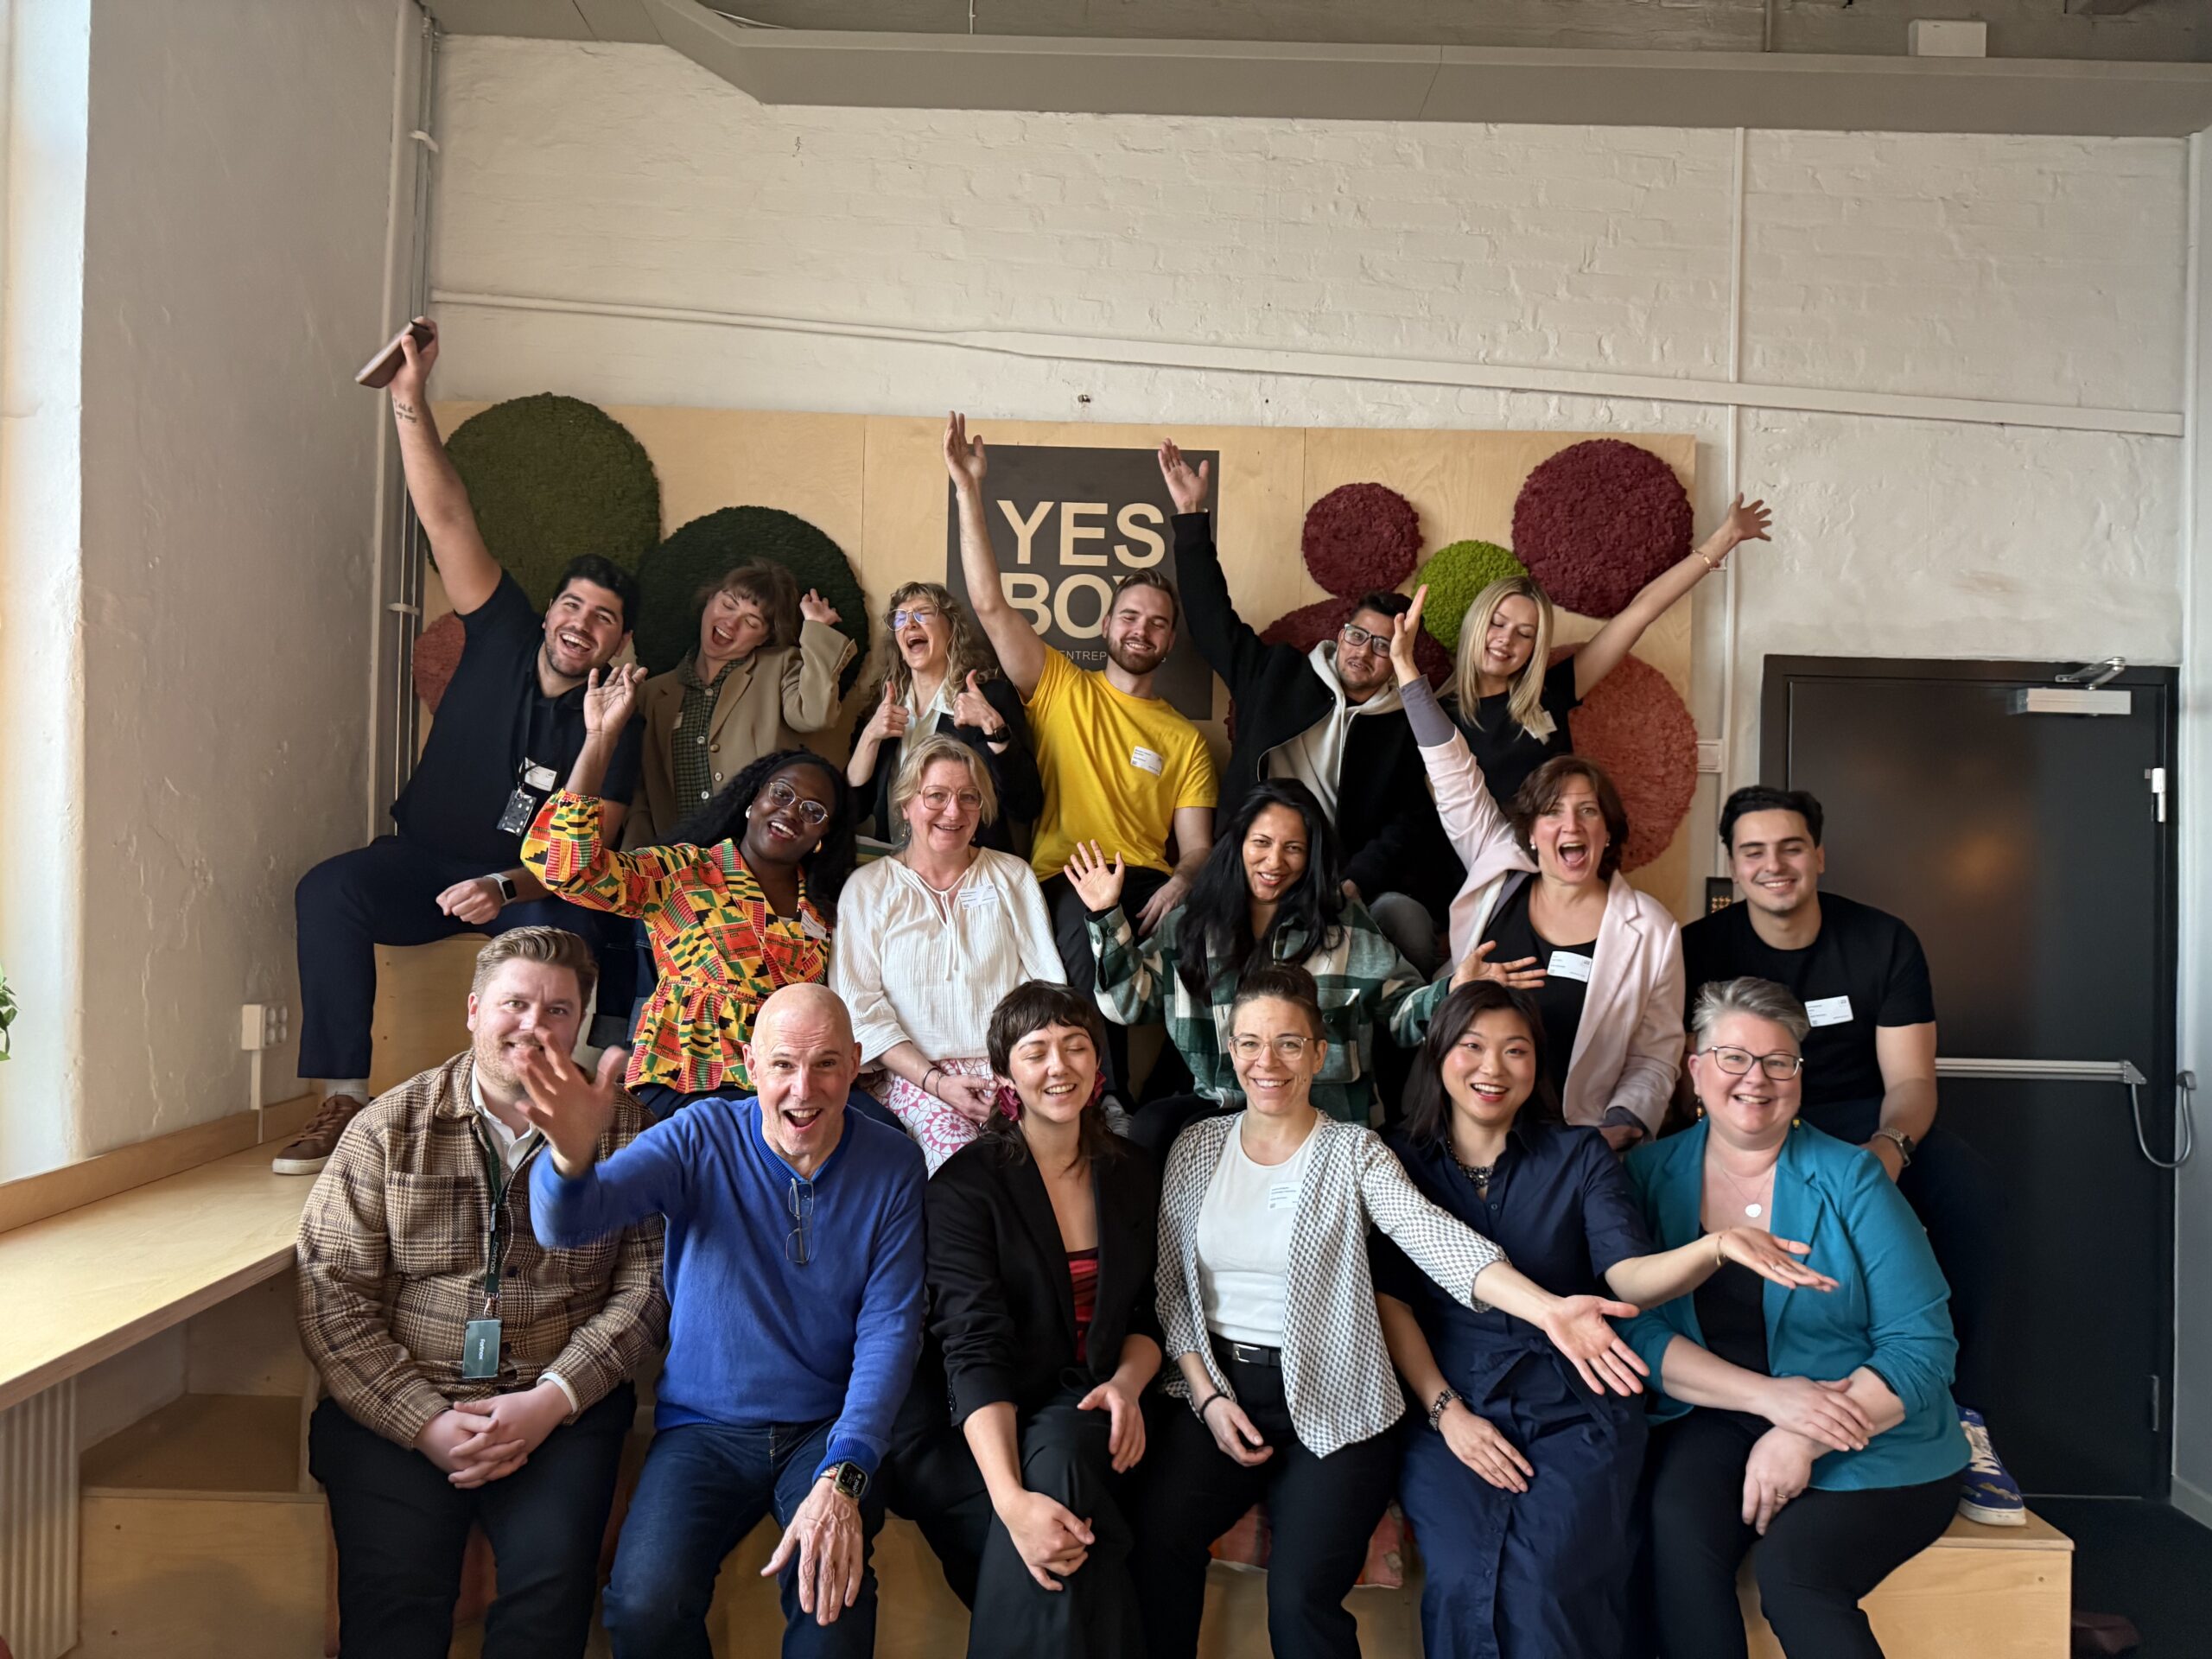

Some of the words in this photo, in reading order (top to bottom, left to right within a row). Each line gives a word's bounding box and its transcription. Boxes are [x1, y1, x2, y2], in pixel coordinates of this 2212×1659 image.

[996, 499, 1165, 568] YES
[1000, 572, 1124, 639] BO
[489, 1242, 499, 1274] Fortnox
